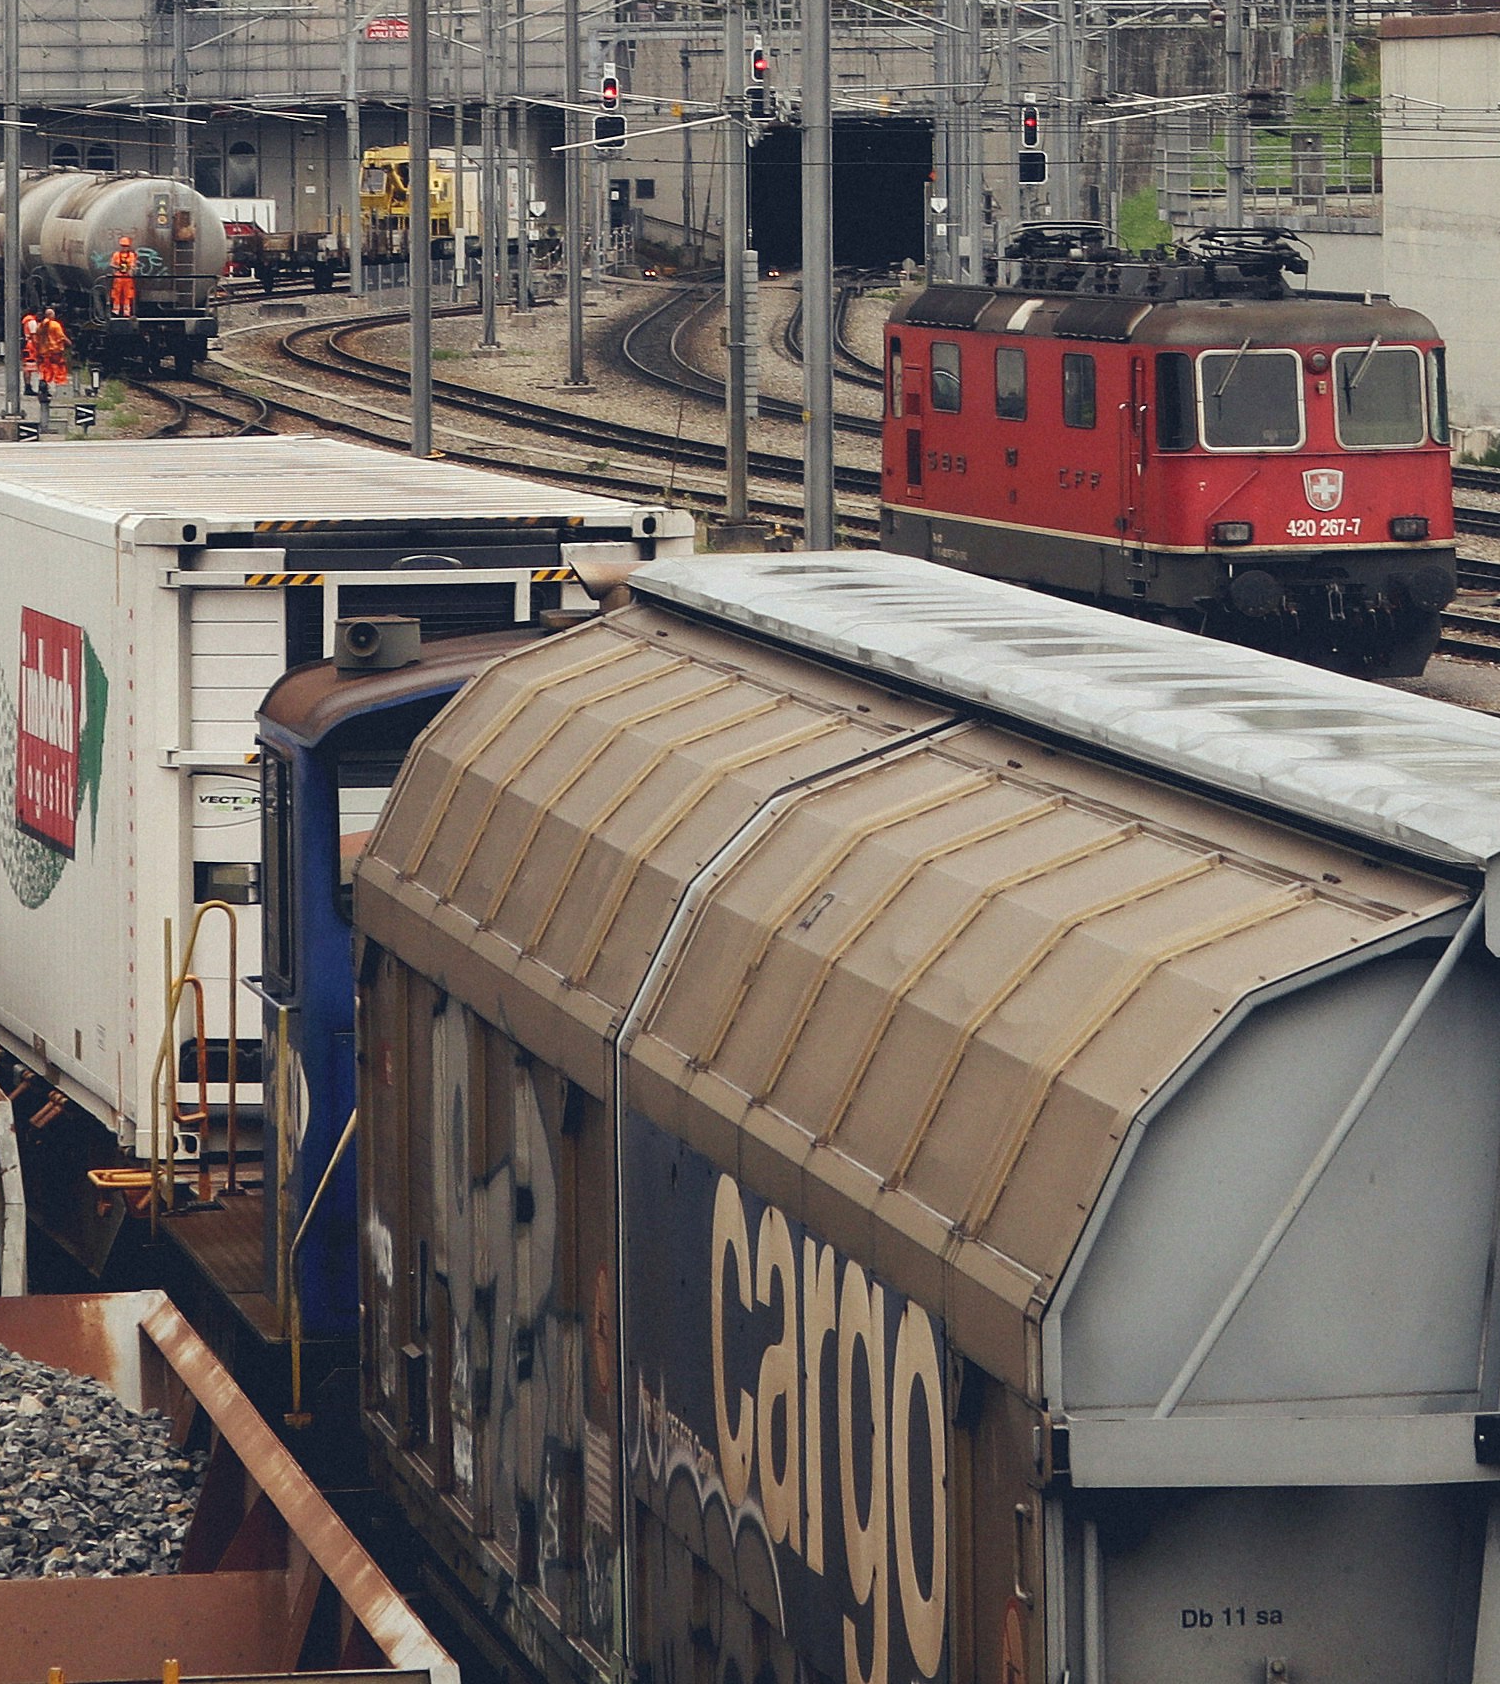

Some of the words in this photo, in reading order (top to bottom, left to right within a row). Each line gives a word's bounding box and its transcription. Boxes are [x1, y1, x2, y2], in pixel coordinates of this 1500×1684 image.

[1286, 519, 1316, 537] 420
[1320, 518, 1361, 536] 267-7
[20, 630, 75, 755] imbach
[21, 736, 76, 822] logistik
[711, 1173, 947, 1684] cargo
[1181, 1609, 1213, 1628] Db
[1222, 1607, 1246, 1626] 11
[1256, 1609, 1283, 1625] sa
